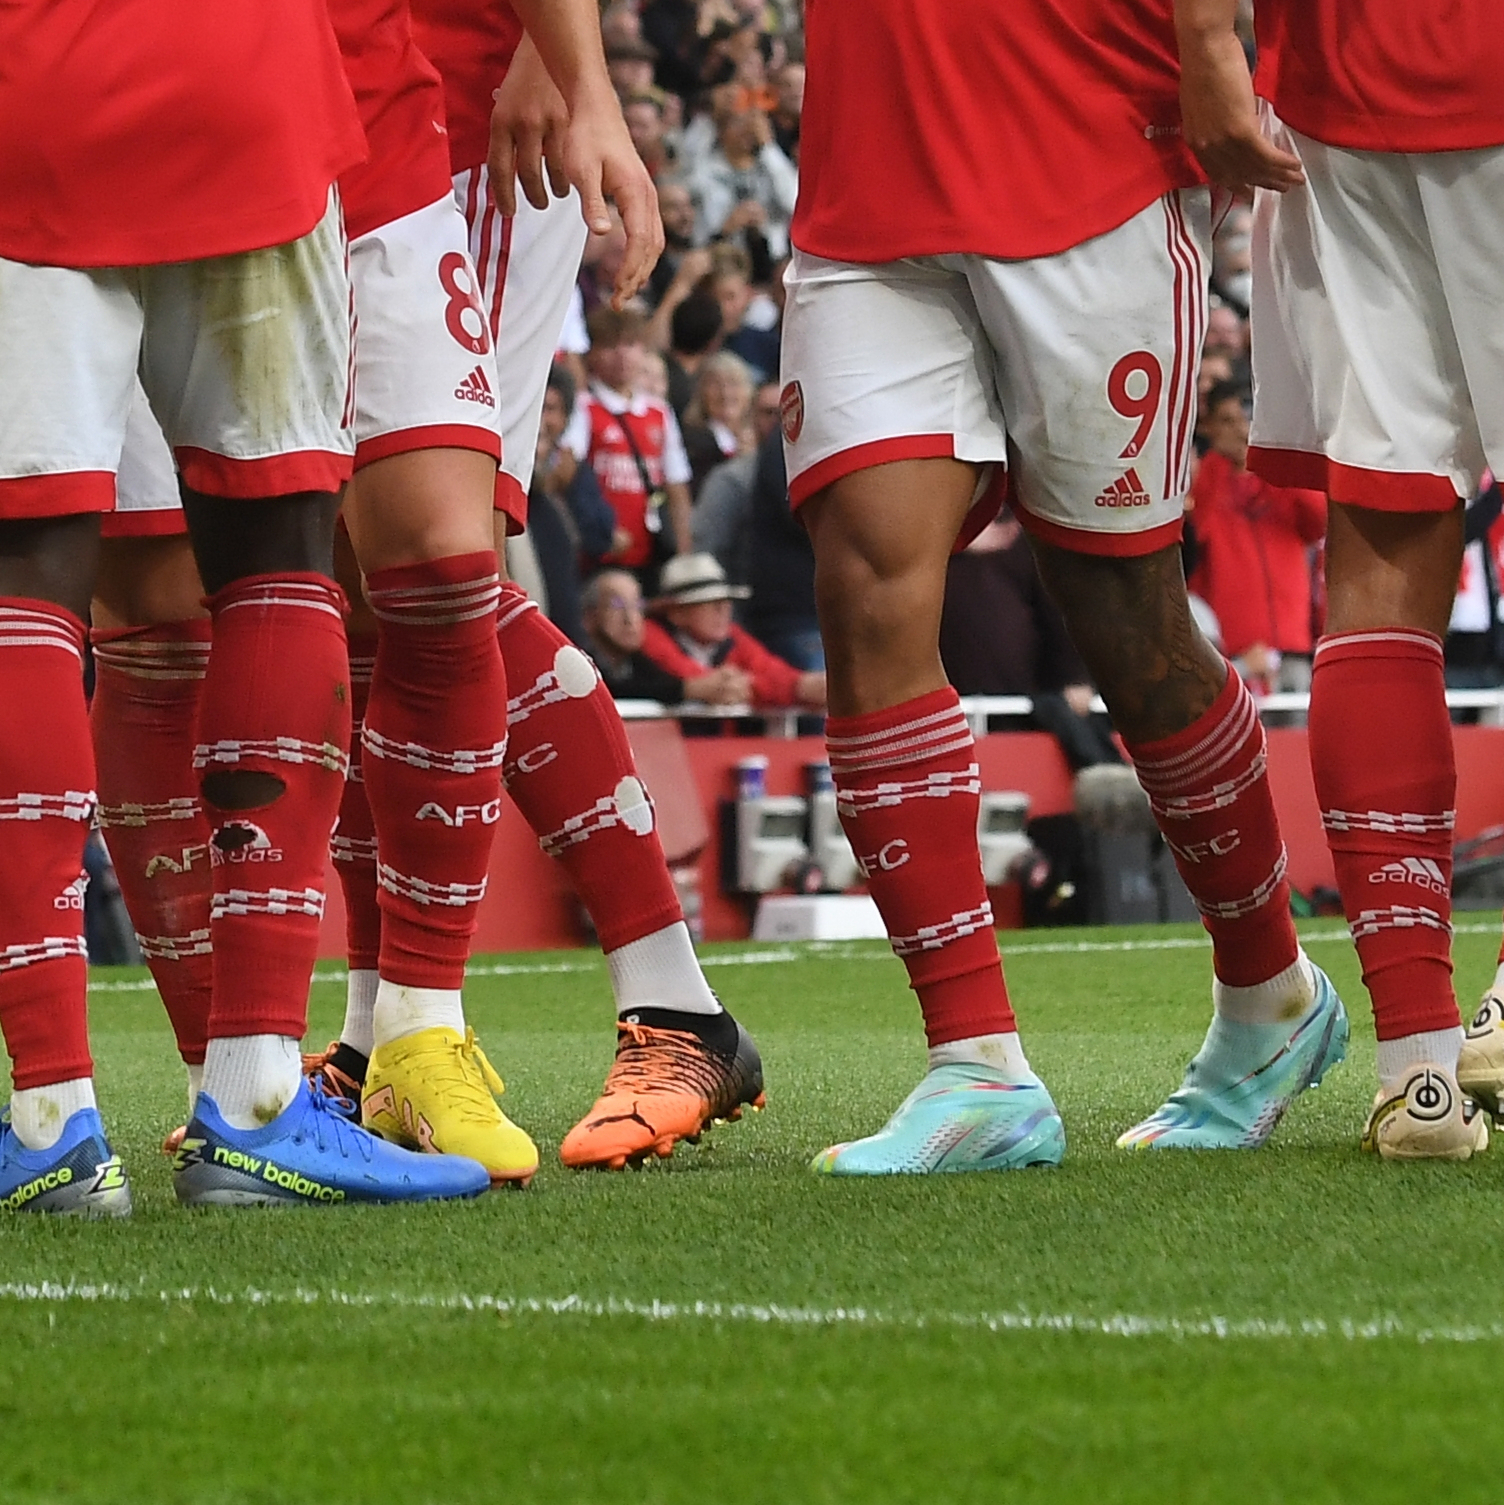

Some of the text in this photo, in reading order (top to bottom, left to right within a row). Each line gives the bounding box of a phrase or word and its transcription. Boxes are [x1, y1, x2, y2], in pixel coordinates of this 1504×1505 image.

[438, 251, 491, 356] 8
[1107, 350, 1163, 459] 9
[1094, 489, 1151, 508] adidas
[415, 797, 501, 828] AFC
[146, 844, 207, 880] AF
[859, 838, 911, 879] FC
[1368, 866, 1451, 899] adidas
[213, 1145, 347, 1205] new balance
